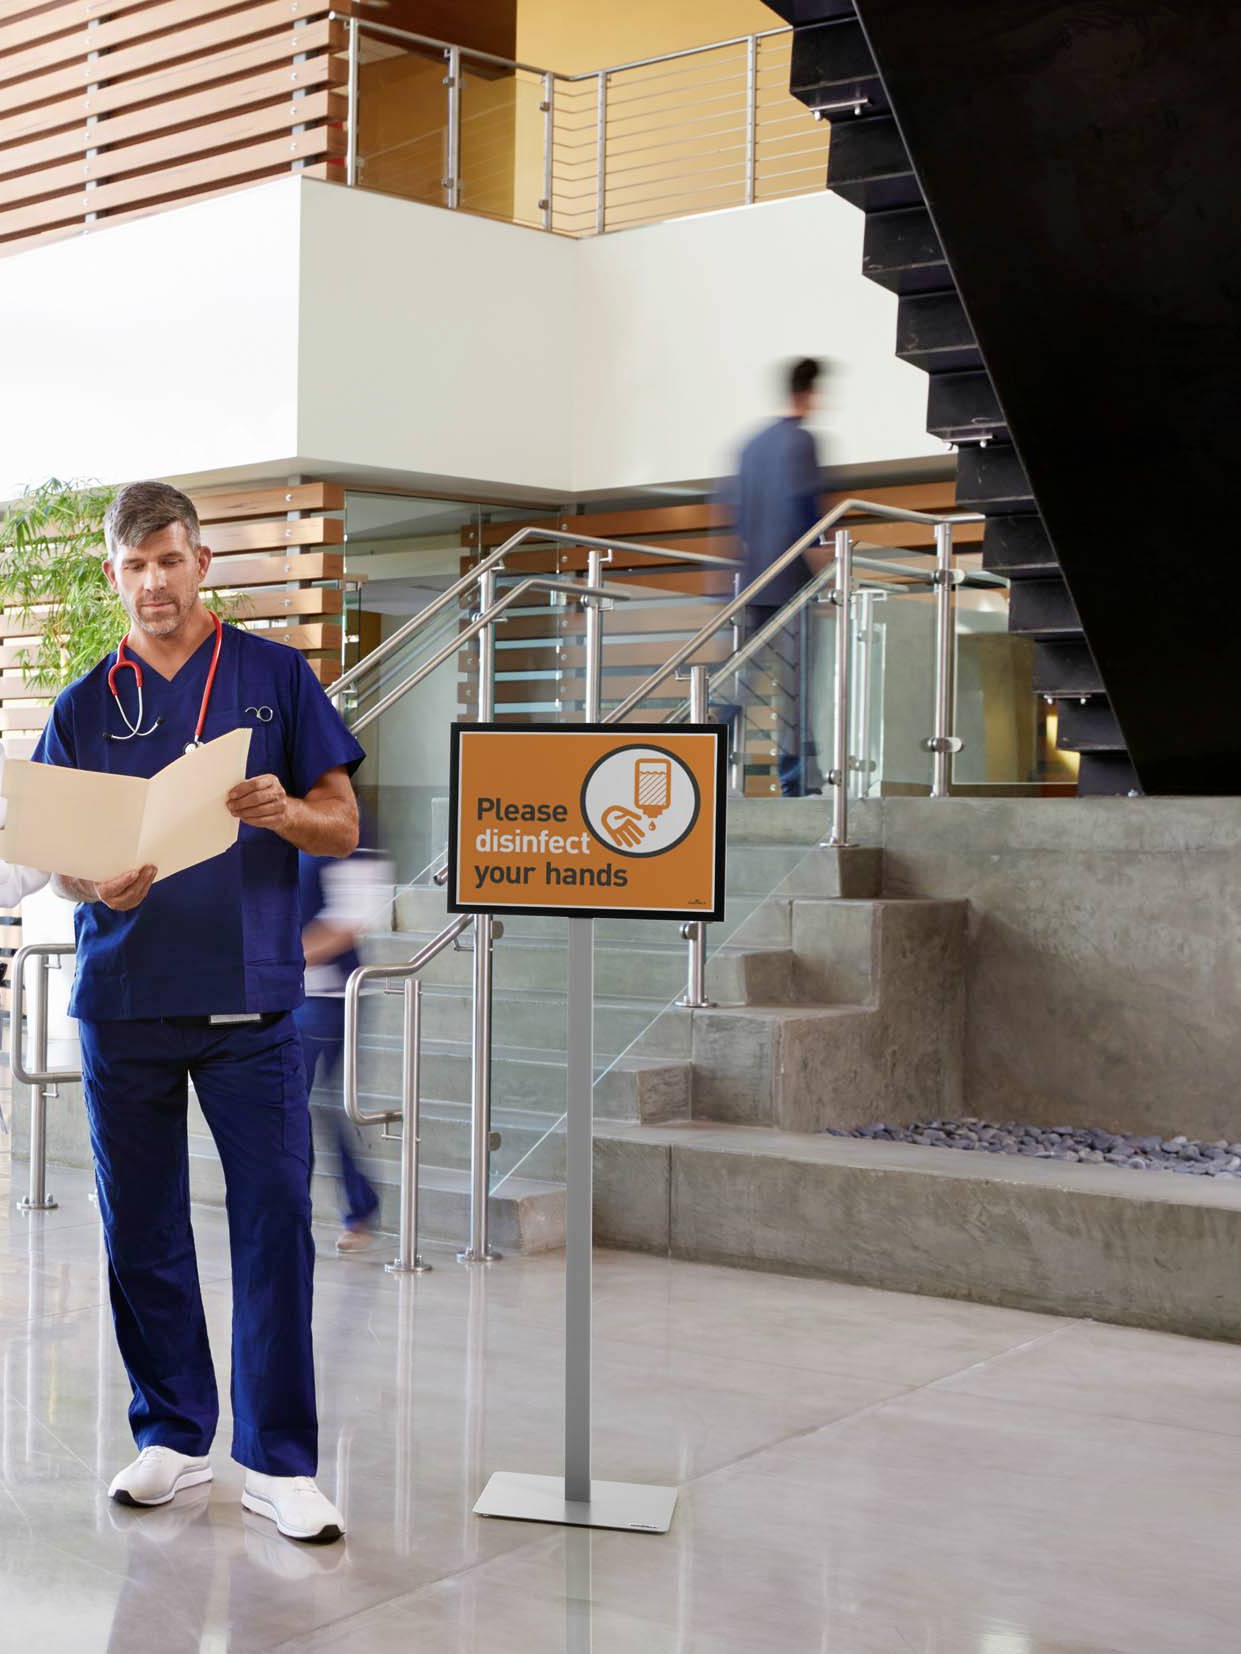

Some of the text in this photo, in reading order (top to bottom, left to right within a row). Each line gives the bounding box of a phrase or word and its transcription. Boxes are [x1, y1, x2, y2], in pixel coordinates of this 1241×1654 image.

[477, 797, 568, 822] Please
[475, 829, 590, 854] disinfect
[474, 861, 628, 889] your hands
